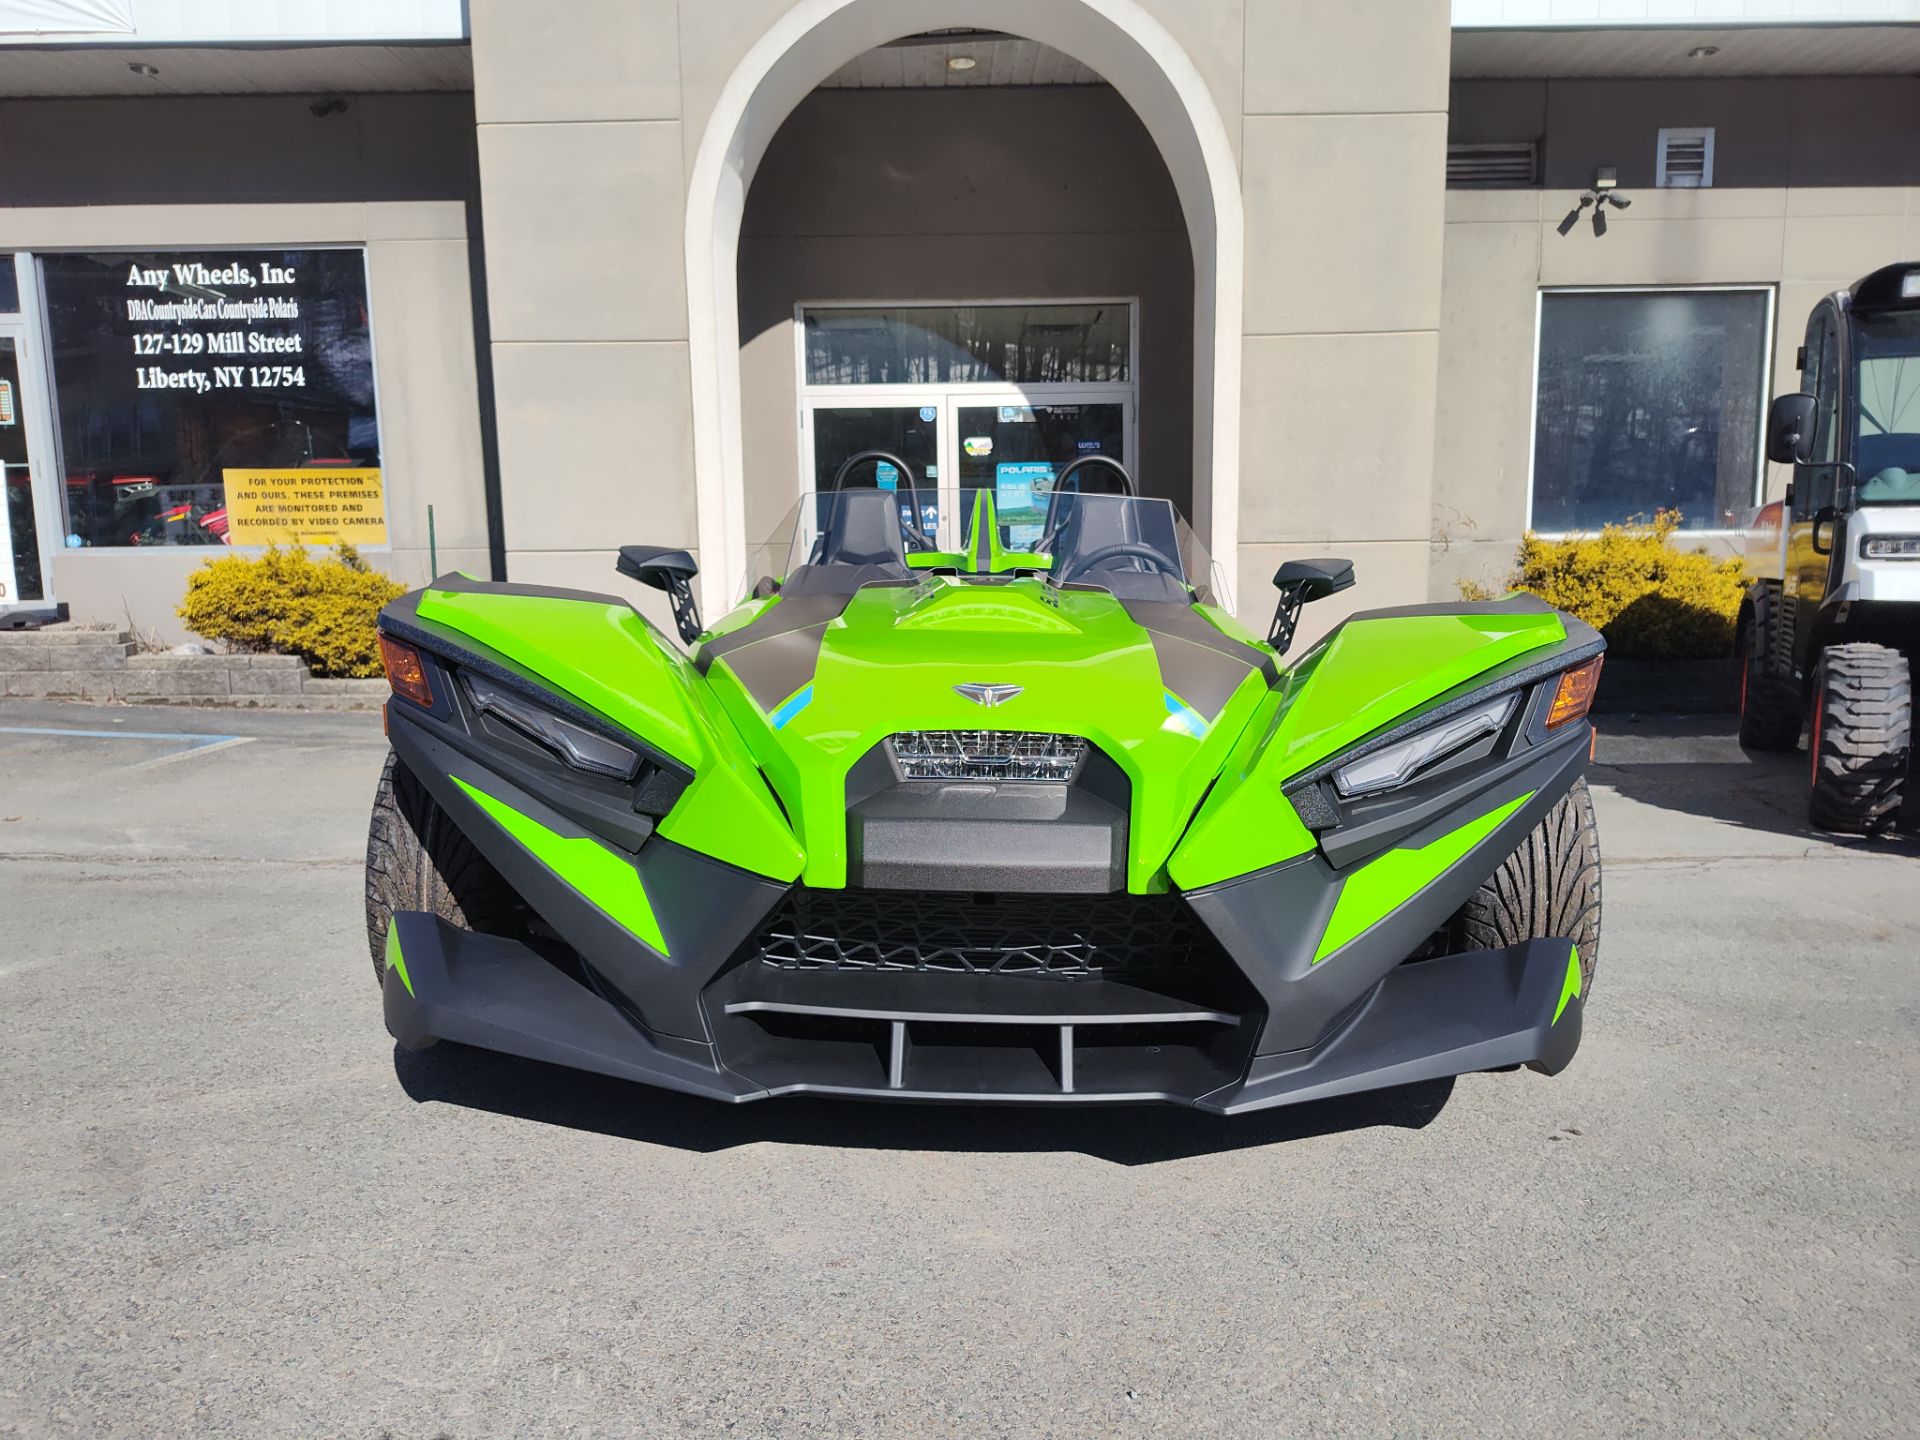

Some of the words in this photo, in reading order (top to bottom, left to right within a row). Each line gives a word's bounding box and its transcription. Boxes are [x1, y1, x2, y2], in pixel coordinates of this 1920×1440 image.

[126, 264, 169, 291] Any
[172, 262, 256, 288] Wheels,
[260, 262, 296, 284] Inc
[127, 299, 148, 320] DBA
[148, 298, 197, 325] Countryside
[198, 299, 217, 320] Cars
[217, 297, 268, 324] Countryside
[268, 297, 299, 319] Polaris
[133, 333, 204, 355] 127-129
[207, 331, 246, 354] Mill
[249, 332, 303, 353] Street
[136, 367, 211, 394] Liberty,
[213, 366, 245, 388] NY
[249, 366, 306, 388] 12754
[1000, 466, 1047, 474] POLARIS
[248, 478, 267, 486] FOR
[270, 478, 297, 486] YOUR
[301, 477, 364, 486] PROTECTION
[237, 491, 258, 499] AND
[261, 491, 290, 500] OURS,
[294, 491, 326, 499] THESE
[329, 490, 380, 499] PREMISES
[255, 504, 274, 513] ARE
[278, 504, 338, 512] MONITORED
[342, 504, 364, 512] AND
[237, 518, 288, 526] RECORDED
[291, 518, 305, 526] BY
[308, 518, 340, 526] VIDEO
[342, 517, 385, 526] CAMERA
